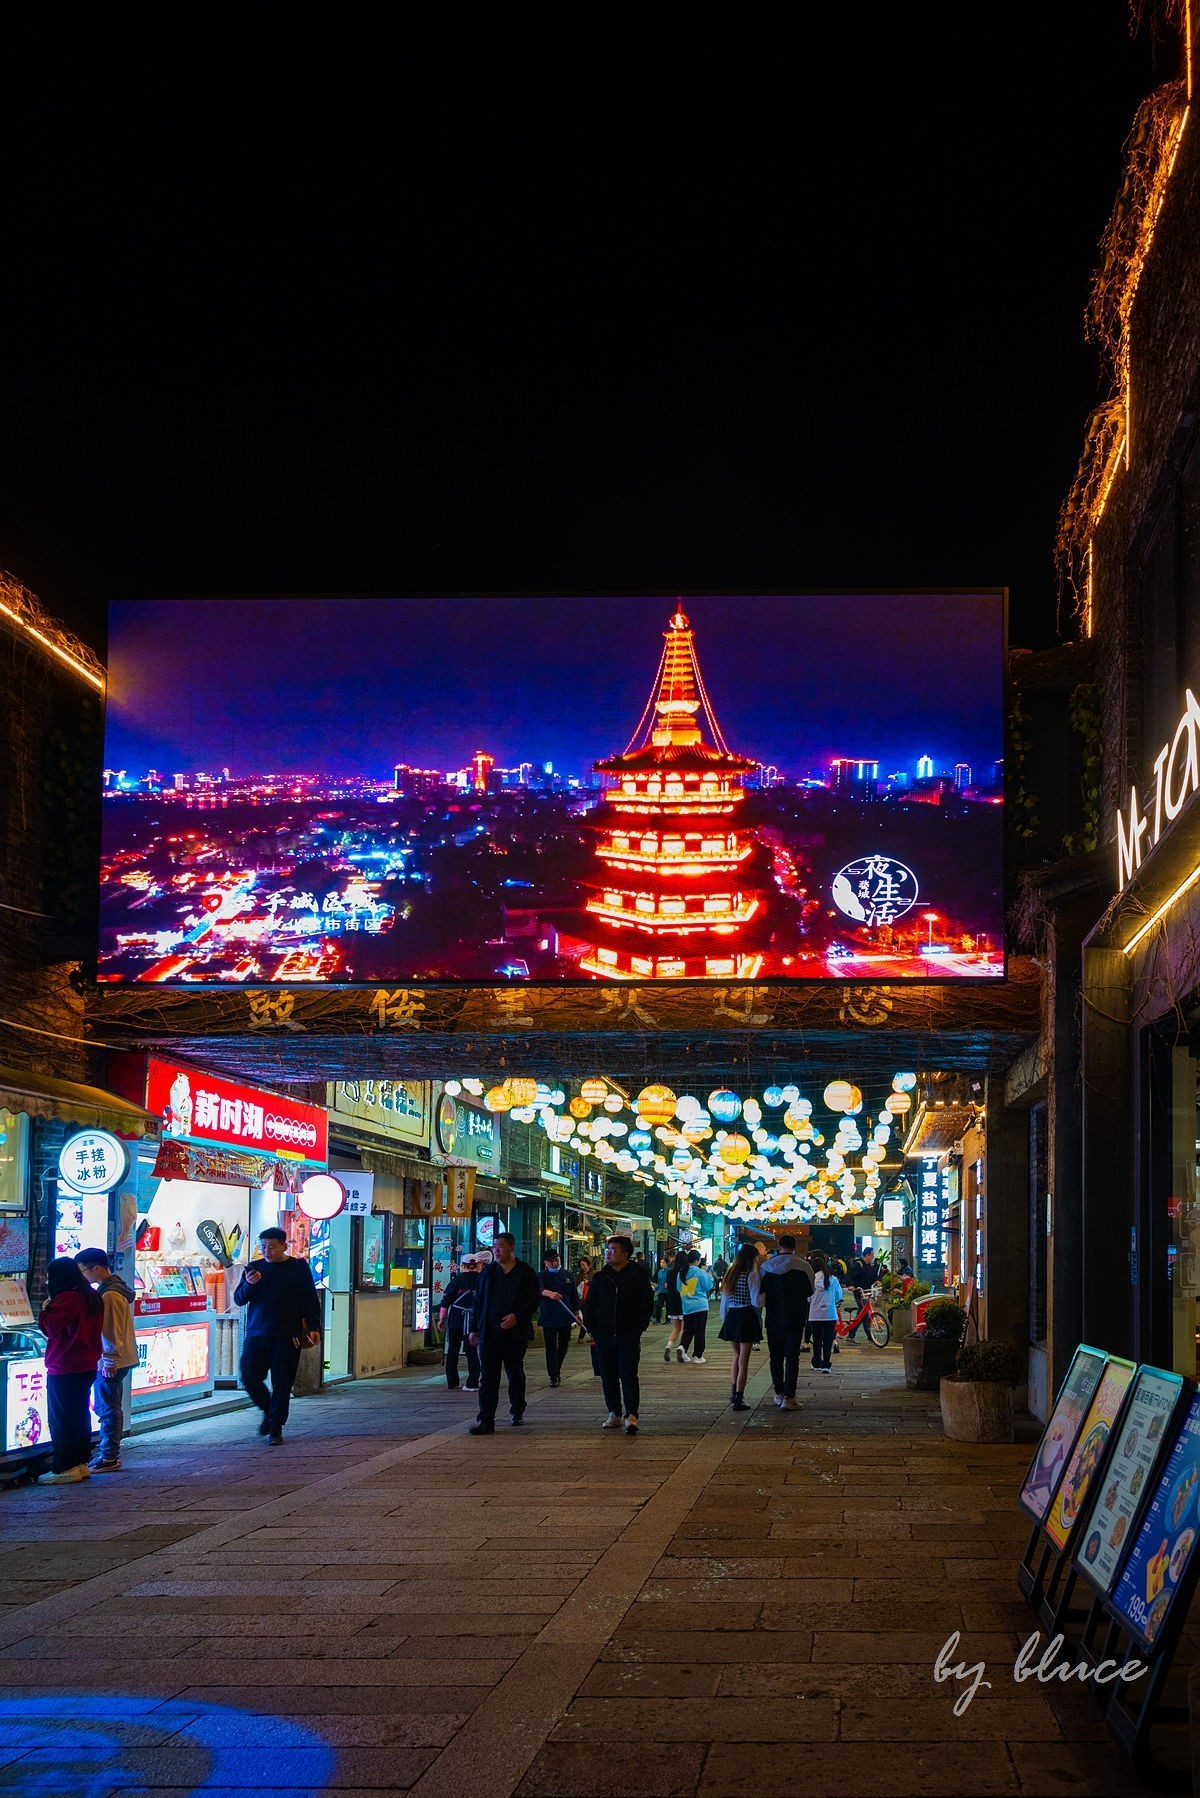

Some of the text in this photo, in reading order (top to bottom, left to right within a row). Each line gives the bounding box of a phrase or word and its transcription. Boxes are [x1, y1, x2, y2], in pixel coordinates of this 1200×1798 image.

[860, 854, 902, 927] 夜生活
[75, 1147, 106, 1164] 手搓
[77, 1164, 107, 1181] 冰粉
[921, 1155, 938, 1265] 宁夏盐池滩羊
[1127, 1593, 1145, 1622] 199
